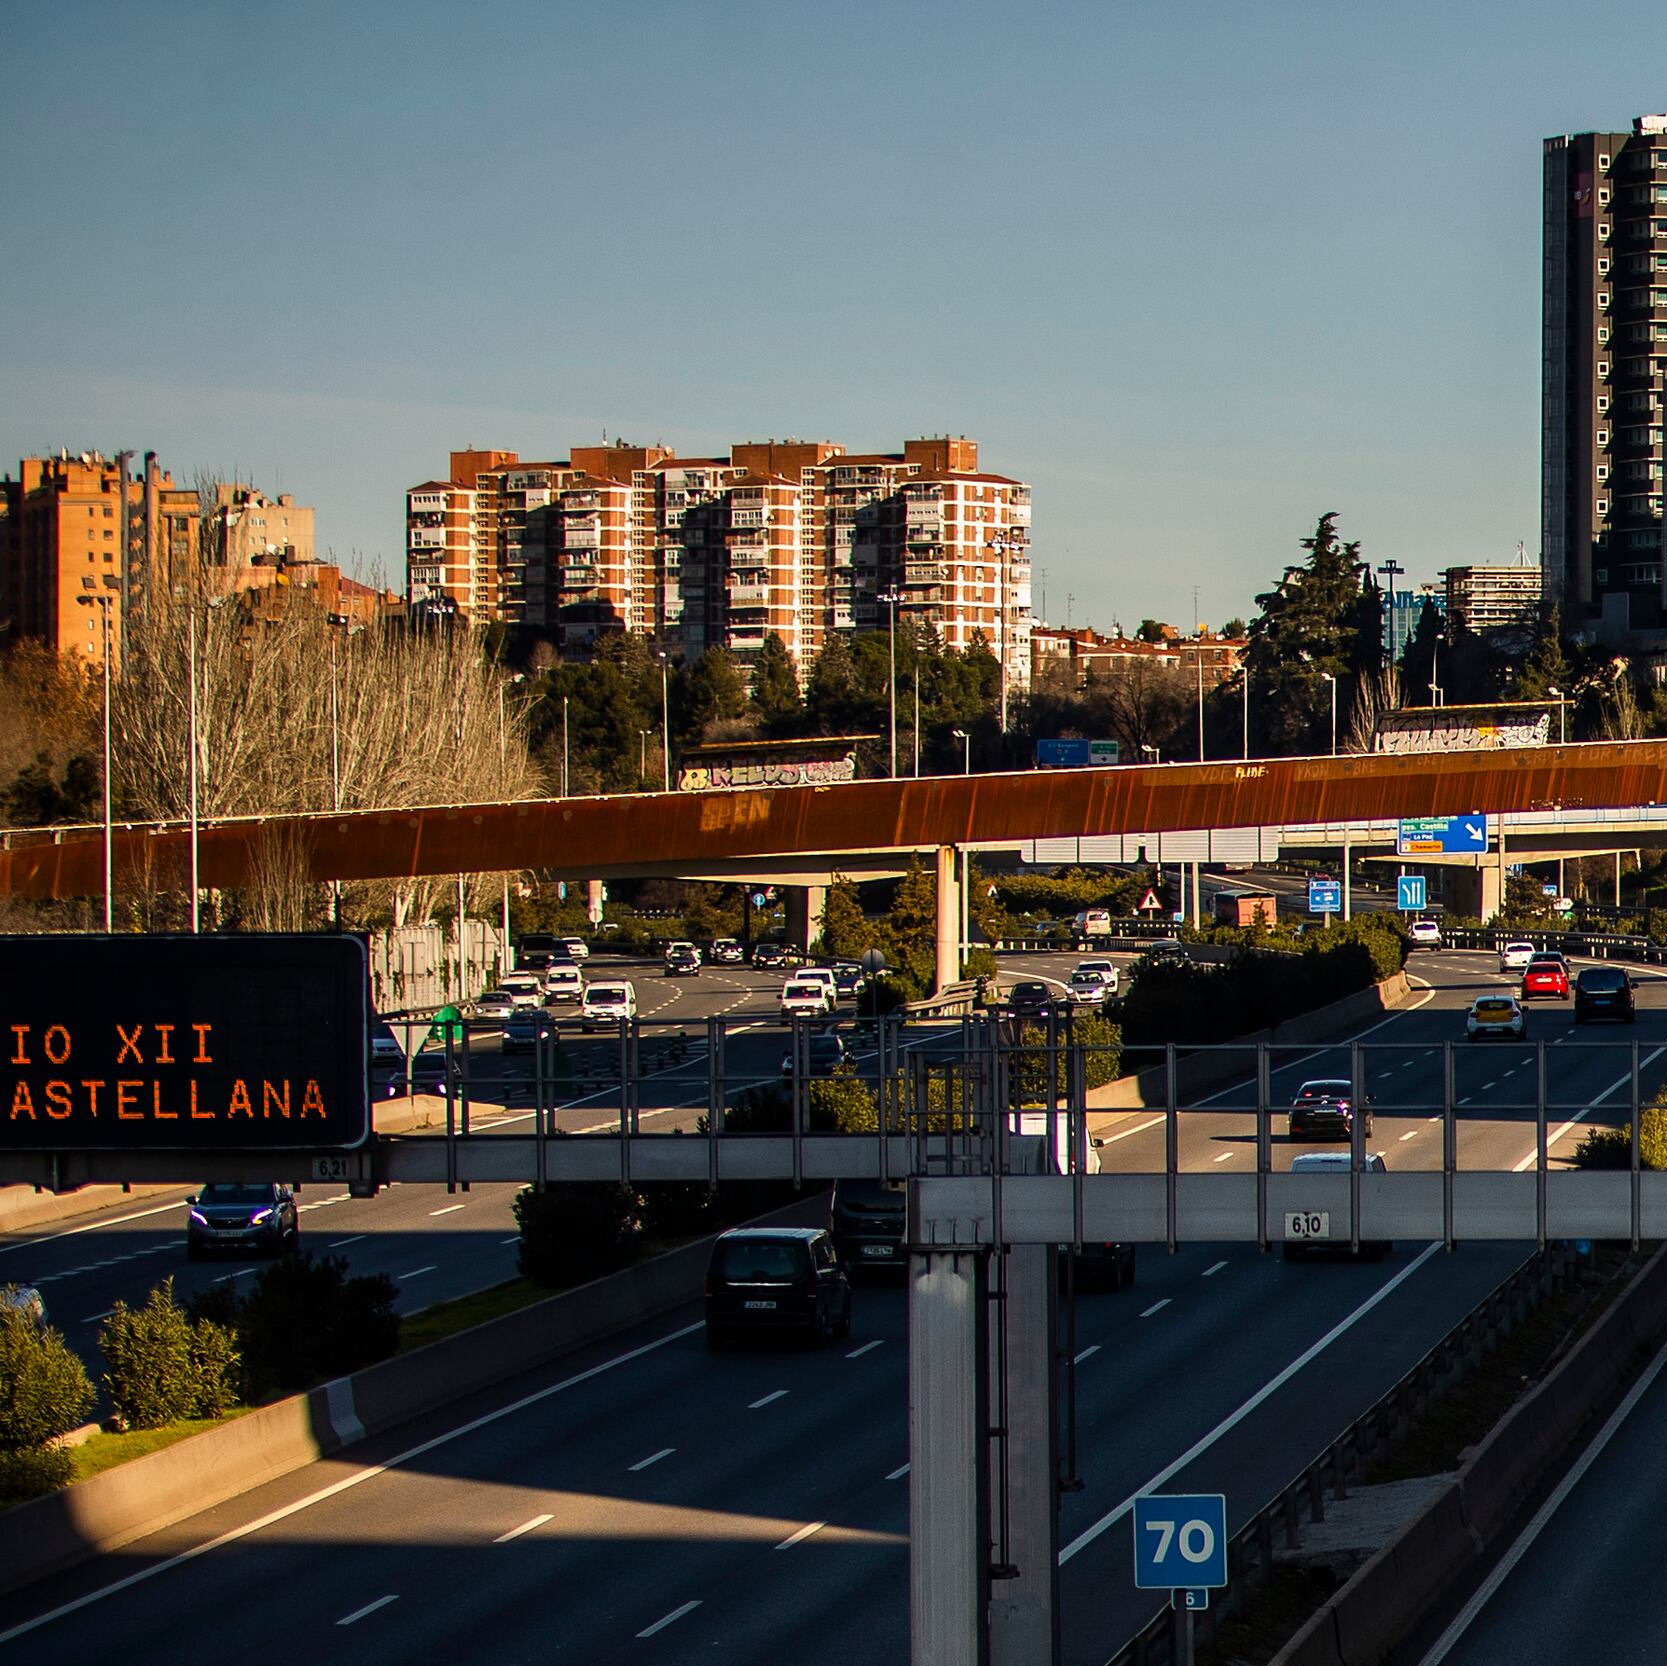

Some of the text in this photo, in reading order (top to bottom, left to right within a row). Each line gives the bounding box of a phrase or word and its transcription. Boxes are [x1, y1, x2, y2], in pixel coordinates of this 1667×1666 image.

[9, 1023, 214, 1064] IO XII
[9, 1079, 327, 1119] ASTELLANA
[1292, 1216, 1321, 1234] 6,10
[1145, 1519, 1215, 1563] 70
[1185, 1591, 1196, 1606] 6
